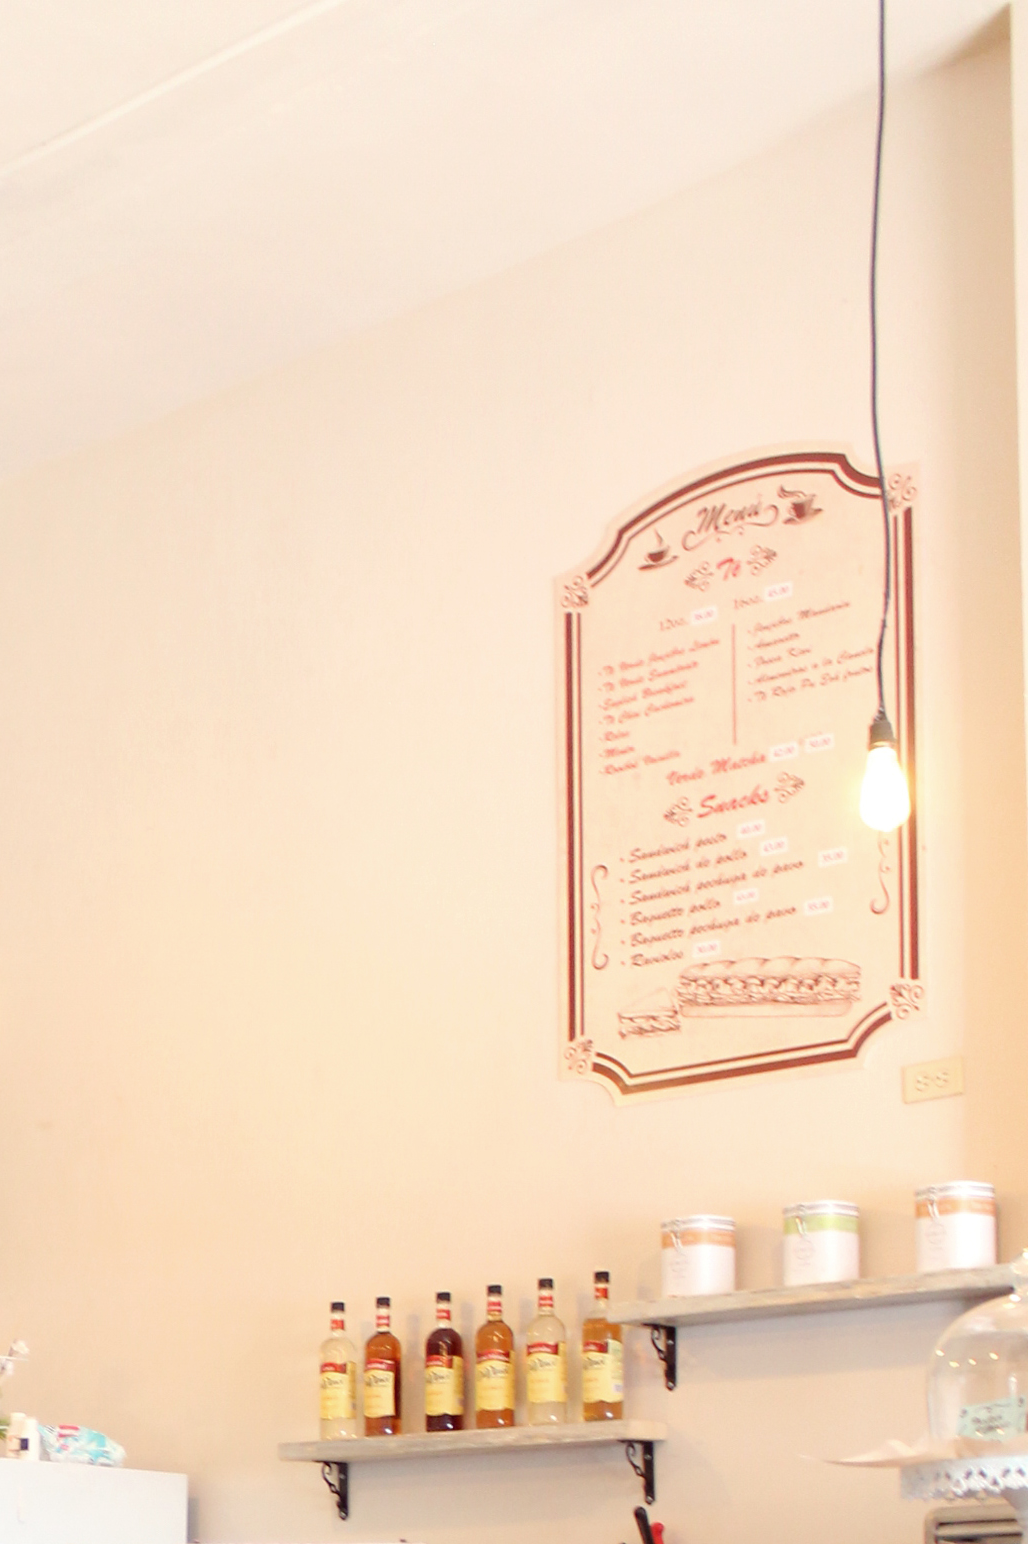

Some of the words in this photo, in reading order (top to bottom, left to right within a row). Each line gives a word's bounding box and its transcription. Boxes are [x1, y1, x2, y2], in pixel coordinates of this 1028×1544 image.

[710, 752, 766, 774] Matcha
[696, 783, 770, 819] Snacks
[628, 840, 690, 864] Sandwich
[628, 858, 691, 884] Sandwich
[695, 857, 711, 869] de
[715, 848, 748, 867] pollo
[628, 880, 691, 905] Sandwich
[752, 866, 768, 878] de
[772, 860, 804, 879] pavo
[688, 898, 721, 918] pollo
[745, 911, 761, 924] de
[765, 905, 797, 924] pavo
